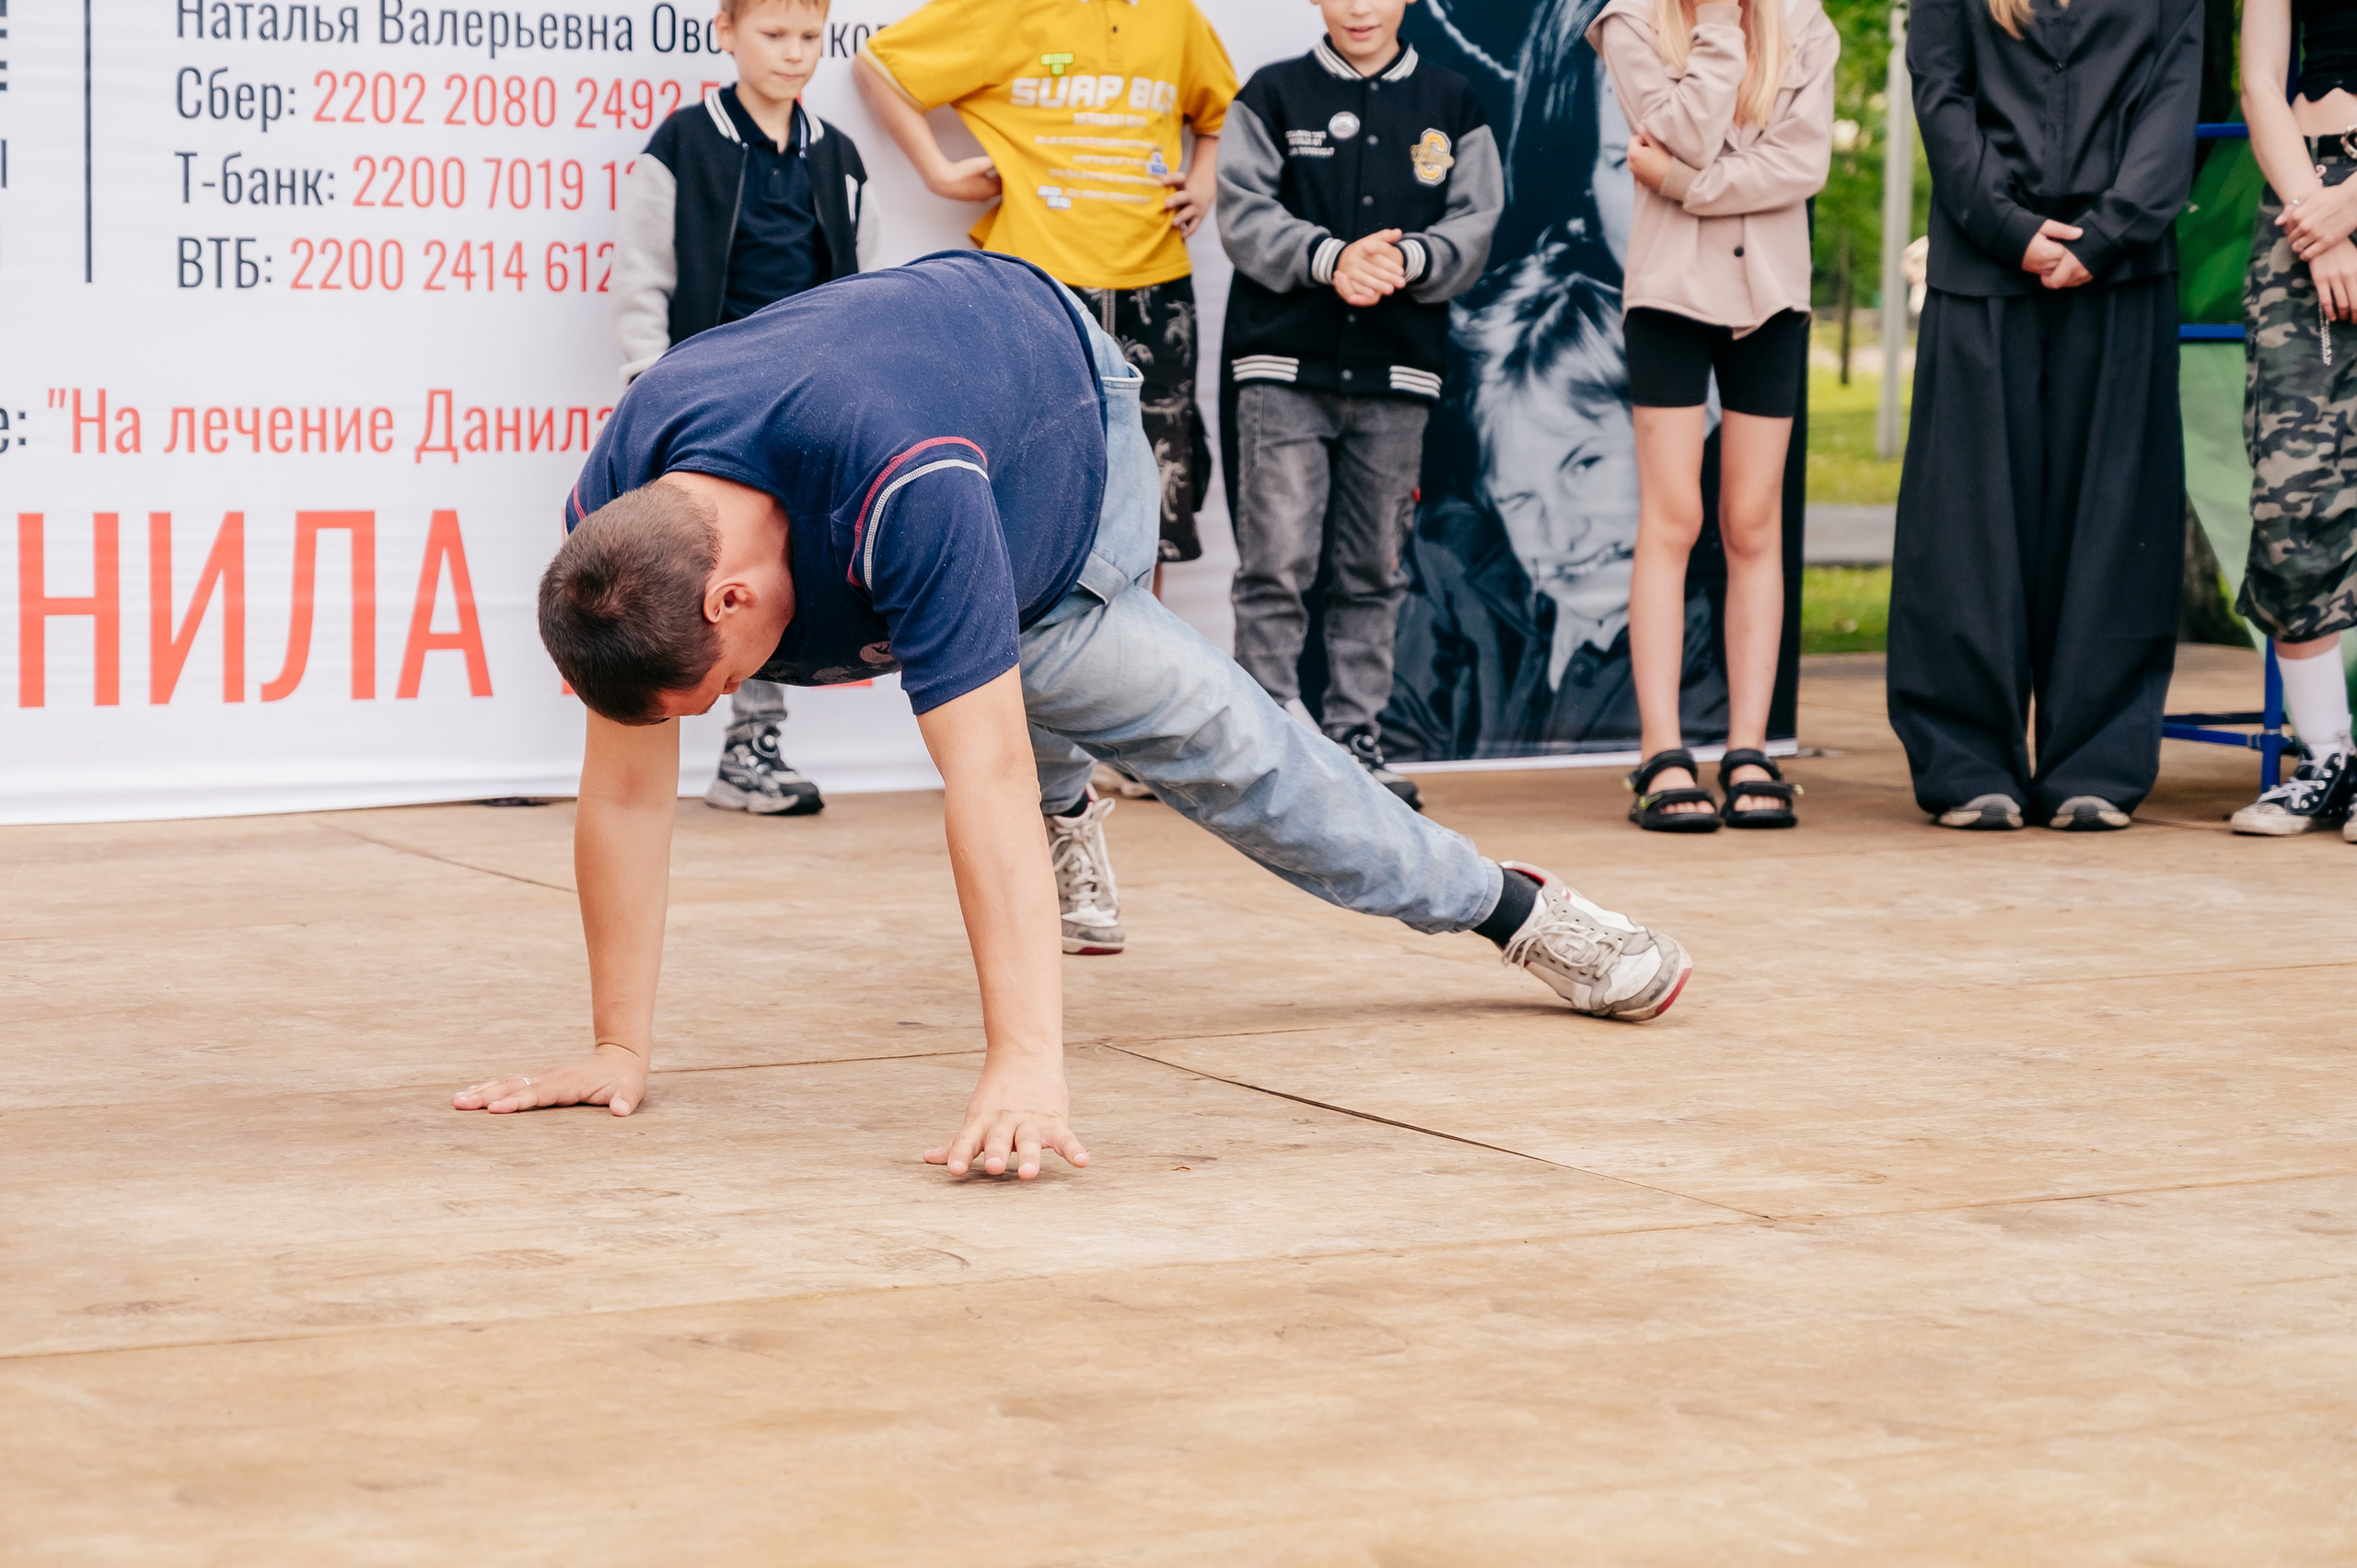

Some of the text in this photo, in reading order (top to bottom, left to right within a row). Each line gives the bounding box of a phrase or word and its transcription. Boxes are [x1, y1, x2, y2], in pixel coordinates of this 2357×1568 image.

[177, 0, 358, 42] Наталья
[378, 0, 633, 59] Валерьевна
[176, 66, 296, 133] Сбер:
[313, 70, 426, 125] 2202
[444, 74, 557, 128] 2080
[175, 151, 335, 206] Т-банк:
[353, 155, 466, 209] 2200
[483, 157, 585, 212] 7019
[178, 236, 273, 290] ВТБ:
[290, 238, 404, 292] 2200
[423, 239, 528, 293] 2414
[47, 388, 142, 454] "На
[163, 406, 394, 454] лечение
[17, 507, 494, 709] НИЛА
